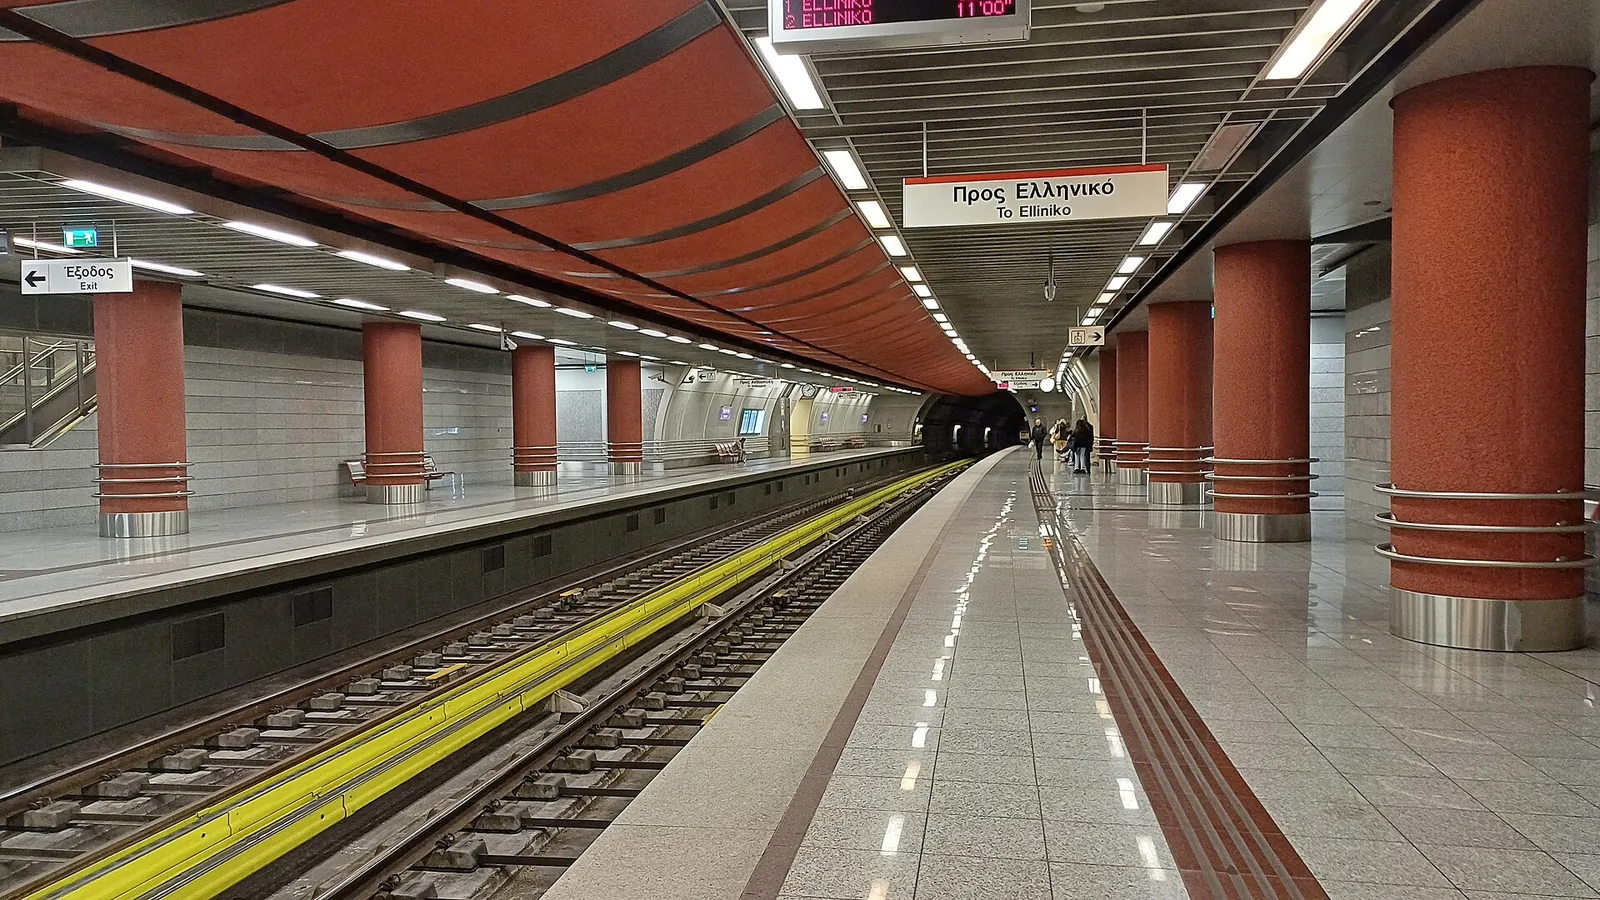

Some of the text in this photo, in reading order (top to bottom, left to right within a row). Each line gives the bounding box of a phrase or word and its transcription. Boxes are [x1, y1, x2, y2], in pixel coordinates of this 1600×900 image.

[785, 0, 791, 13] 1
[785, 14, 796, 29] 2
[802, 9, 872, 27] ELLINIKO
[953, 178, 1115, 206] Προς Ελληνικό
[996, 204, 1072, 219] To Elliniko
[64, 265, 114, 279] Έξοδος
[80, 281, 98, 291] Exit
